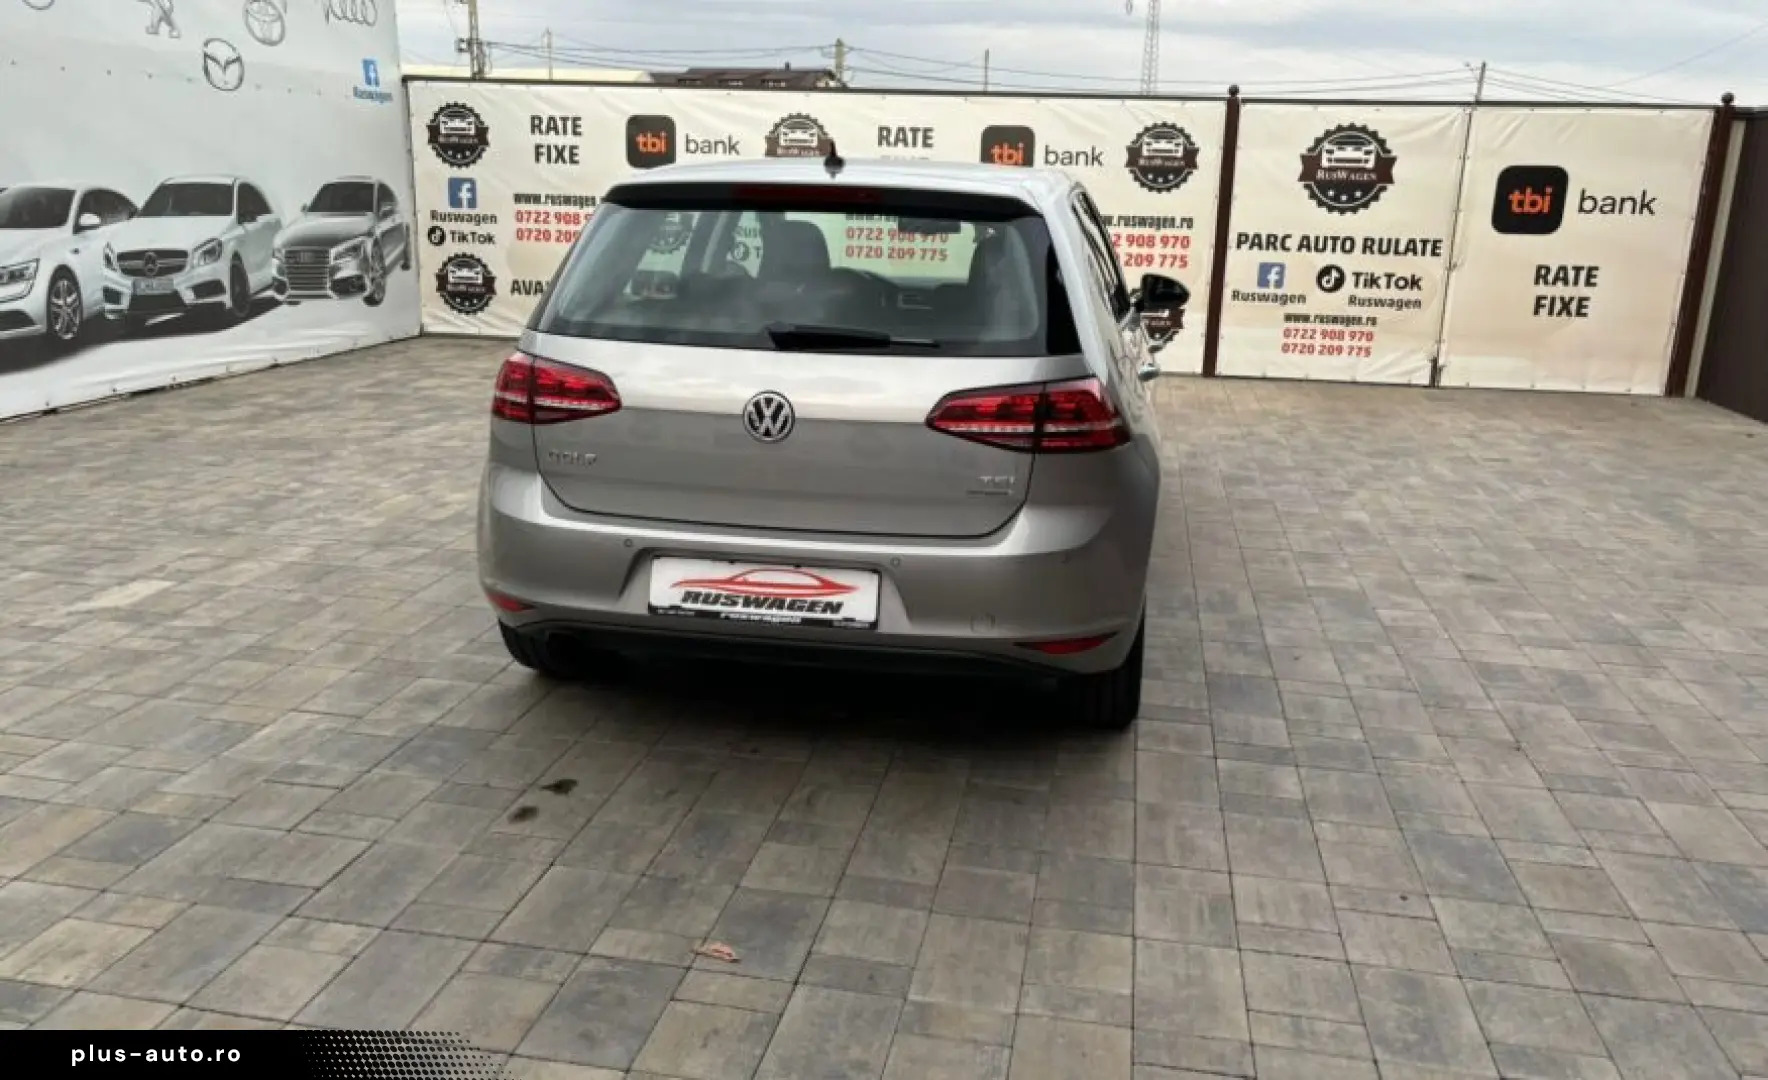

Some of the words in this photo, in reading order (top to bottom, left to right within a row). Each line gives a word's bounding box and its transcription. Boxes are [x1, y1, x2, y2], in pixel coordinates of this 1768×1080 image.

[530, 115, 582, 136] RATE
[635, 132, 668, 153] tbi
[685, 134, 740, 155] bank
[877, 126, 934, 148] RATE
[534, 145, 580, 164] FIXE
[991, 143, 1025, 165] tbi
[1044, 145, 1104, 167] bank
[1509, 187, 1553, 214] tbi
[1577, 188, 1657, 215] bank
[430, 210, 498, 226] Ruswagen
[515, 210, 550, 225] 0722
[554, 212, 581, 226] 908
[450, 230, 496, 245] TikTok
[515, 227, 552, 243] 0720
[845, 227, 884, 241] 0722
[1125, 233, 1156, 249] 908
[1160, 235, 1191, 250] 970
[1236, 232, 1293, 251] PARC
[1296, 235, 1355, 254] AUTO
[1361, 237, 1443, 257] RULATE
[845, 245, 884, 259] 0720
[887, 246, 916, 260] 209
[919, 247, 948, 262] 775
[1124, 252, 1155, 268] 209
[1159, 253, 1189, 269] 775
[1352, 271, 1423, 291] TikTok
[1533, 264, 1600, 288] RATE
[510, 279, 550, 296] AVA
[1231, 290, 1306, 306] Ruswagen
[1348, 294, 1422, 311] Ruswagen
[1532, 294, 1591, 318] FIXE
[1282, 328, 1317, 340] 0722
[1319, 329, 1345, 342] 908
[1347, 330, 1374, 343] 970
[1281, 342, 1315, 355] 0720
[1317, 344, 1343, 356] 209
[1347, 345, 1372, 358] 775
[681, 590, 844, 616] RUSWAGEN
